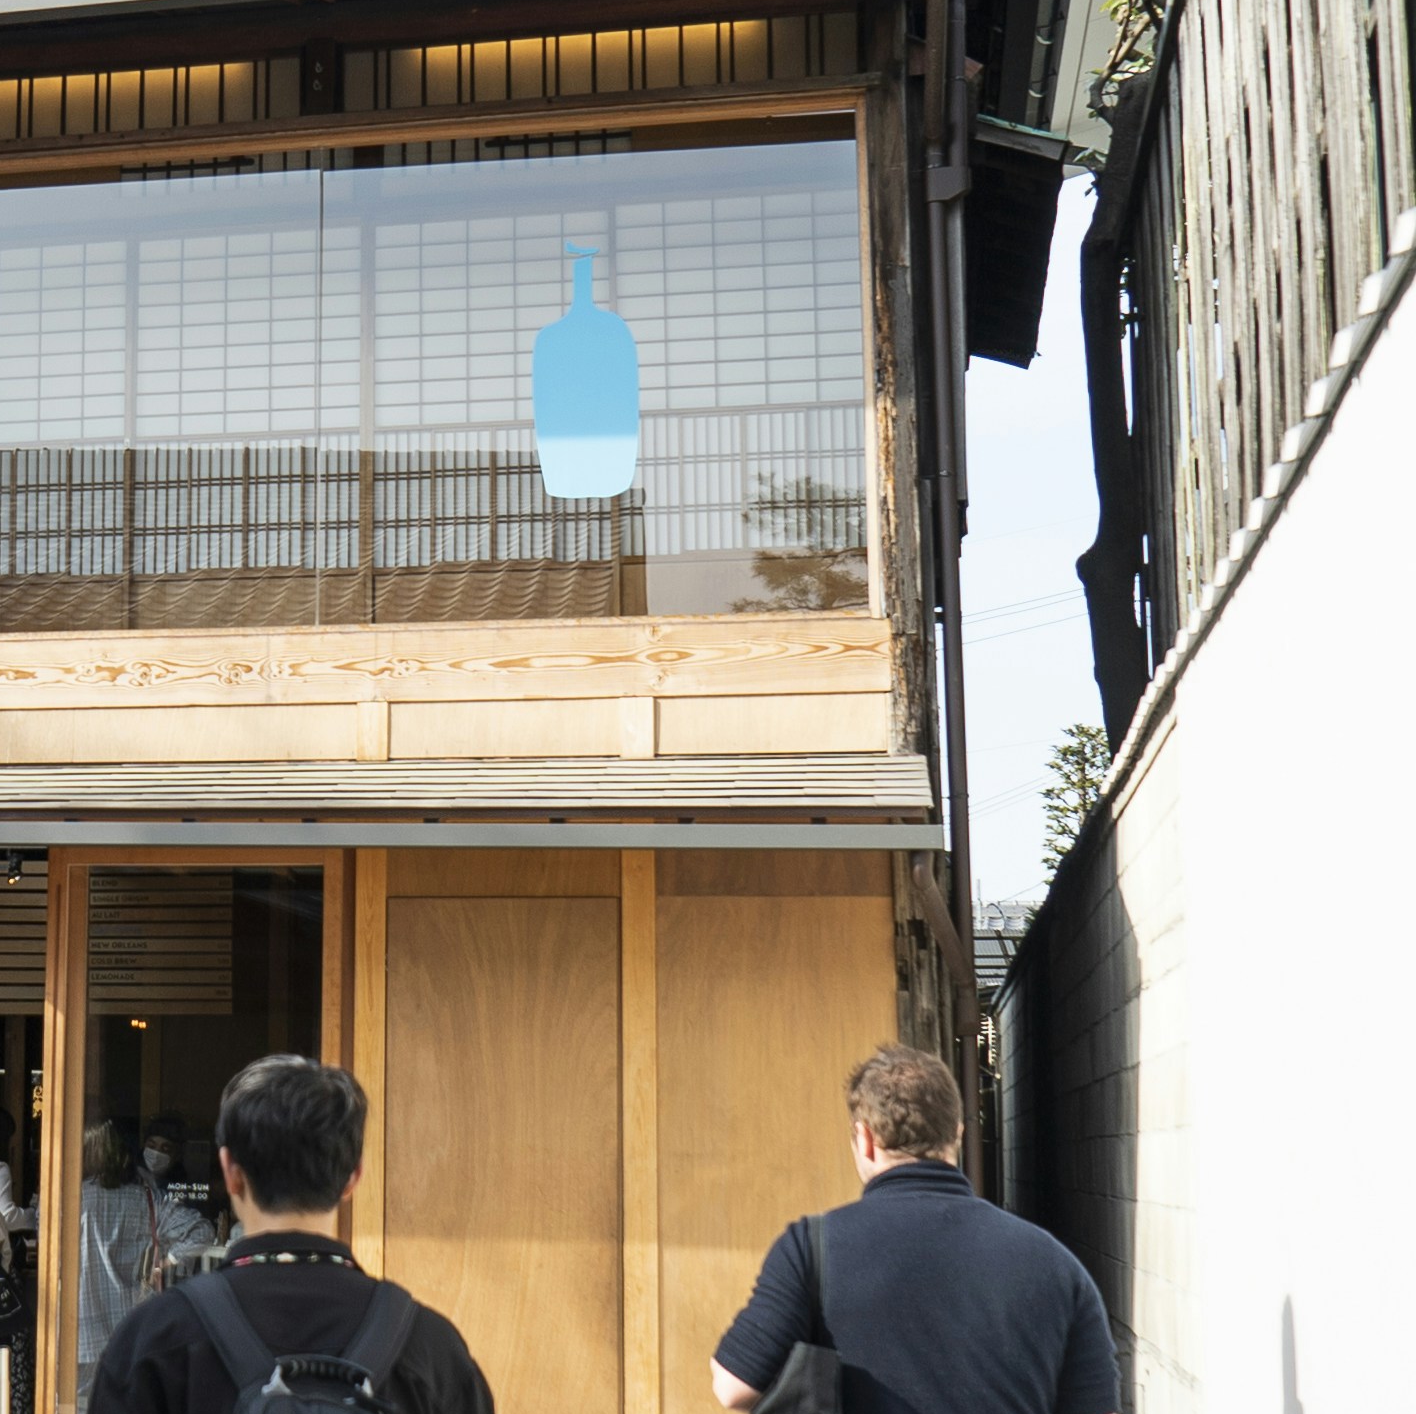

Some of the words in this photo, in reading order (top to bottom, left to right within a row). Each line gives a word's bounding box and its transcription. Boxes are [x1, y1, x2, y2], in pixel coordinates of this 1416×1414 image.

[91, 941, 110, 949] NEW
[111, 941, 148, 949] ORLEANS
[91, 957, 113, 965] COLD
[114, 957, 138, 965] BREW
